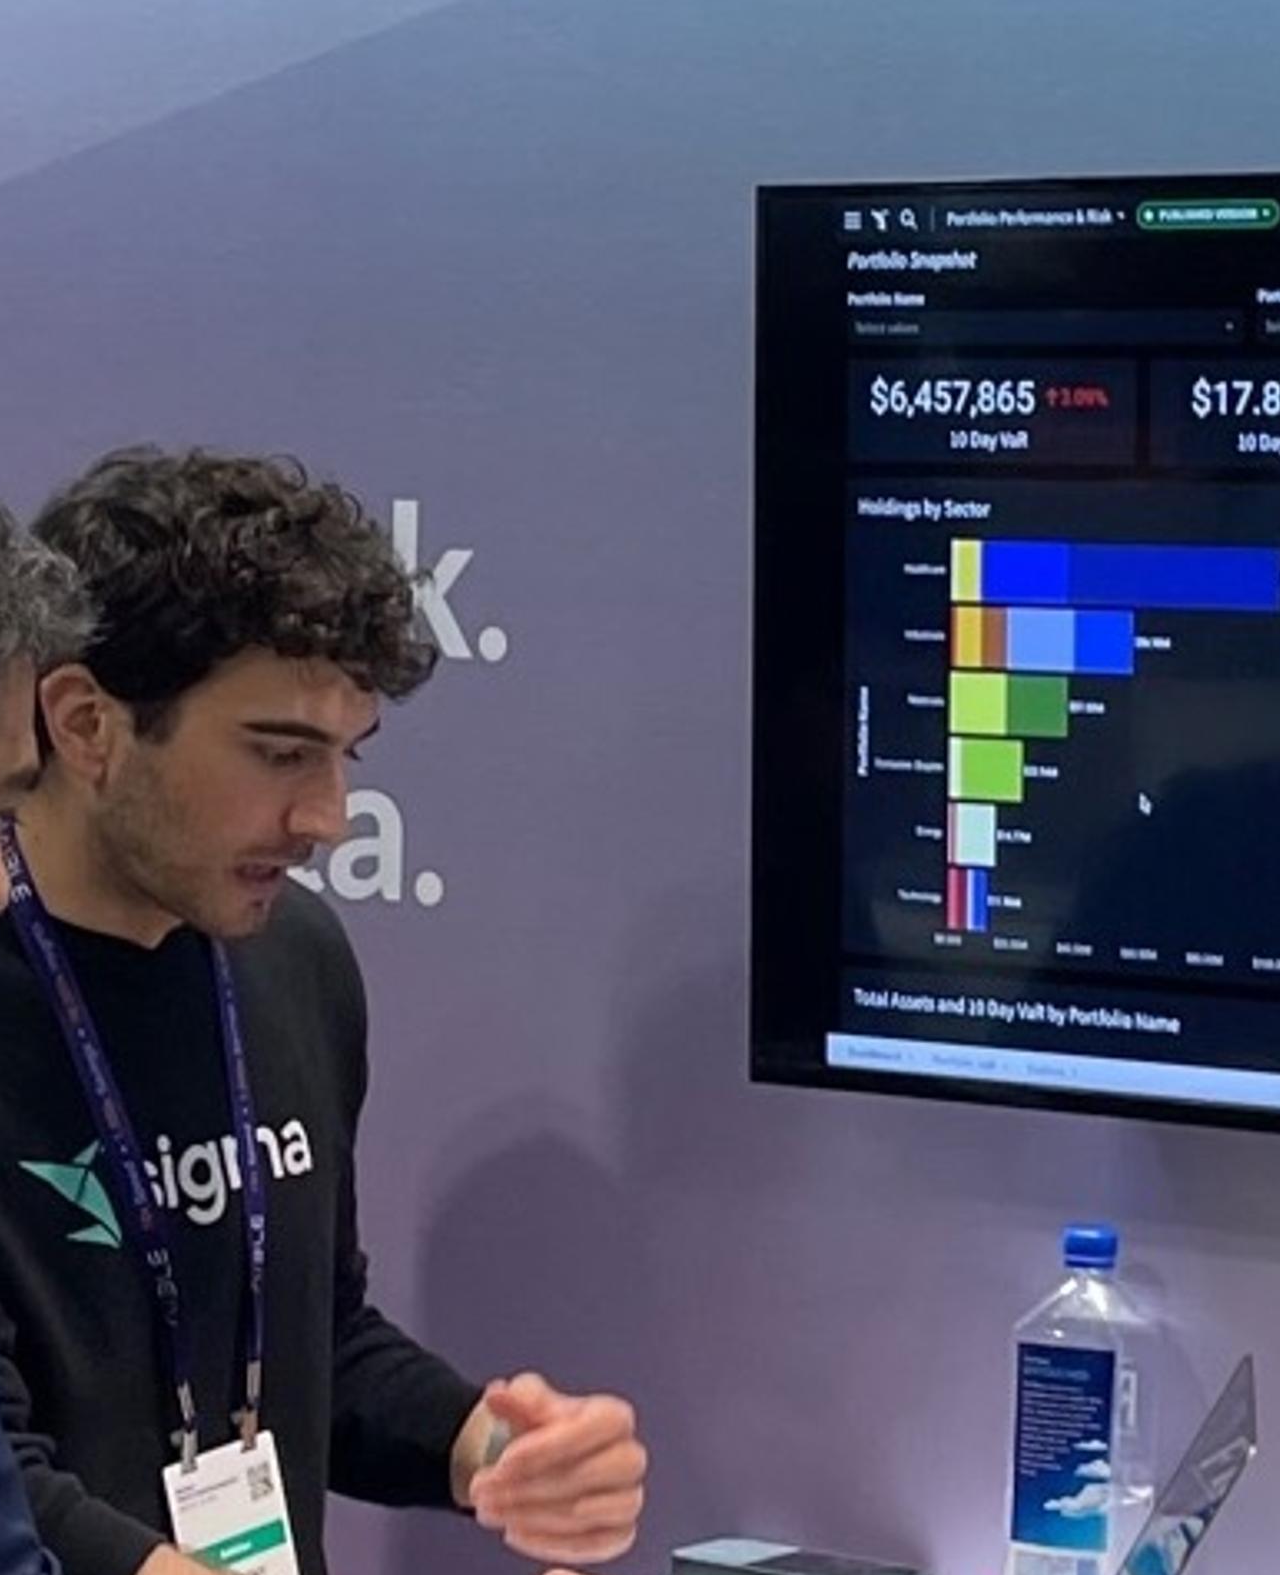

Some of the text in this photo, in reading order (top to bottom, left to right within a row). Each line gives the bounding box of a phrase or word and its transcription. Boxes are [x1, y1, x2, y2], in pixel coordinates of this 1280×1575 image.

[847, 250, 978, 272] Portfolio Snapshot
[869, 374, 1037, 419] $6,457,865
[949, 430, 968, 450] 10
[970, 430, 999, 454] Day
[1237, 433, 1256, 453] 10
[857, 497, 993, 523] Holdings by Sector
[853, 988, 888, 1007] Total
[890, 991, 935, 1014] Assets
[937, 995, 966, 1016] and
[987, 997, 1015, 1024] Day
[1047, 1003, 1067, 1027] by
[1069, 1005, 1132, 1030] Portfolio
[1134, 1011, 1181, 1035] Name
